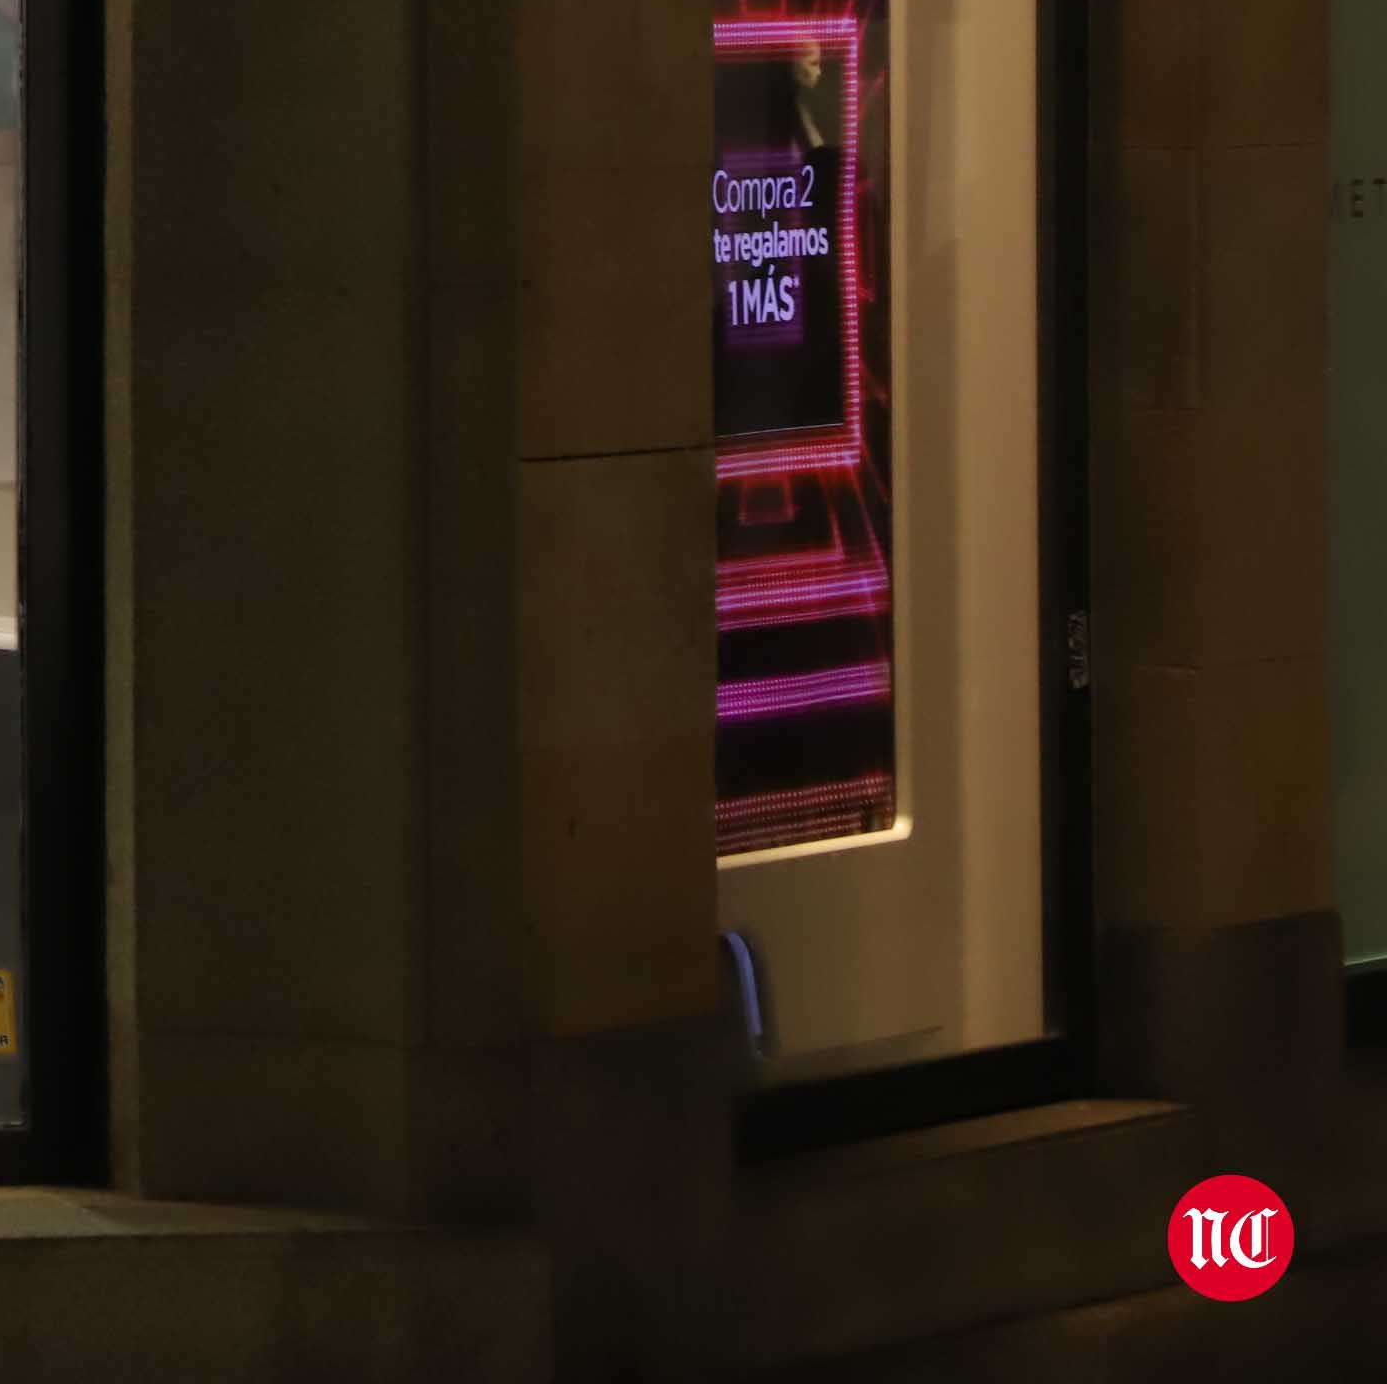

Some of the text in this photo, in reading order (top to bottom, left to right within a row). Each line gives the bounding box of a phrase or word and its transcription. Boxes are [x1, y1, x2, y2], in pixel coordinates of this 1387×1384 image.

[712, 165, 815, 219] Compra 2
[714, 221, 829, 267] te regalamos
[728, 279, 738, 326] 1
